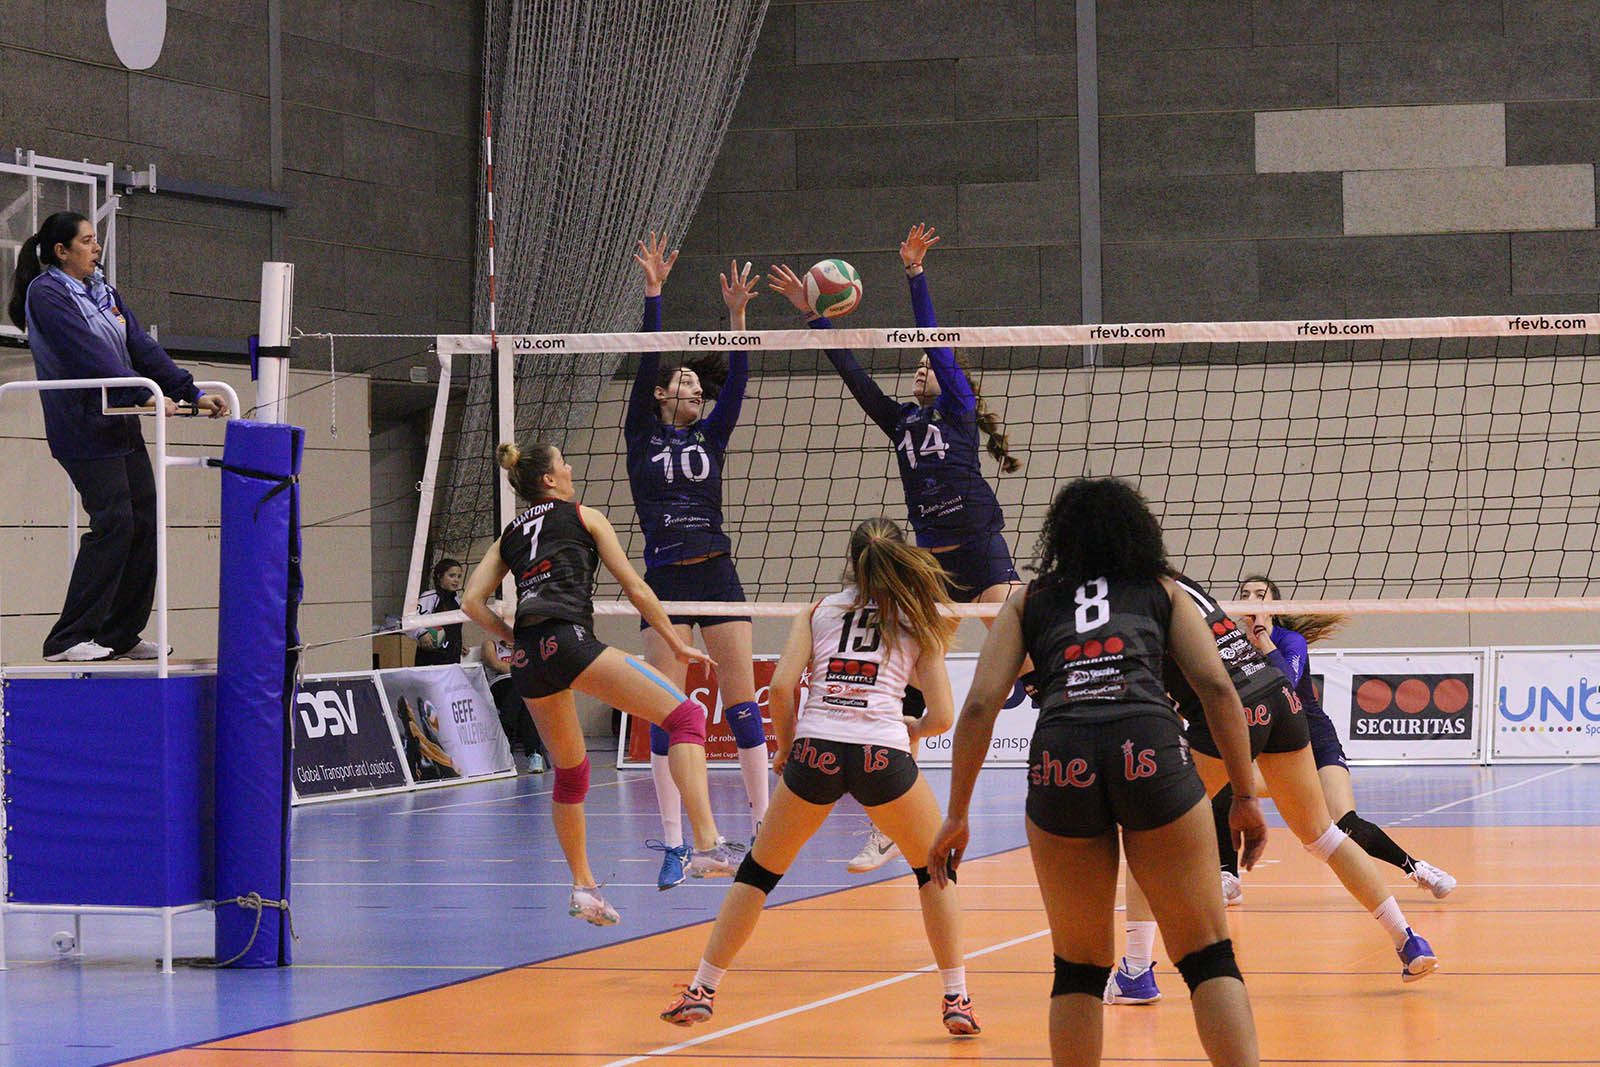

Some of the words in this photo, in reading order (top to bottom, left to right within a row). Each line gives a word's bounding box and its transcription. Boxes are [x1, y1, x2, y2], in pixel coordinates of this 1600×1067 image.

[1090, 326, 1165, 338] rfevb.com
[1297, 322, 1374, 335] rfevb.com
[1509, 317, 1586, 329] rfevb.com
[514, 337, 565, 349] vb.com
[688, 333, 761, 345] rfevb.com
[887, 330, 960, 342] rfevb.com
[897, 423, 950, 469] 14
[651, 444, 710, 483] 10
[522, 514, 545, 561] 7
[1074, 576, 1111, 634] 8
[837, 608, 882, 653] 15
[297, 689, 359, 739] DSV
[1356, 718, 1466, 735] SECURITAS
[925, 735, 951, 750] Glo
[297, 765, 321, 783] Global
[319, 762, 356, 782] Transport
[354, 760, 368, 776] and
[365, 758, 396, 779] Logistics
[863, 744, 888, 773] is
[1121, 739, 1158, 781] is
